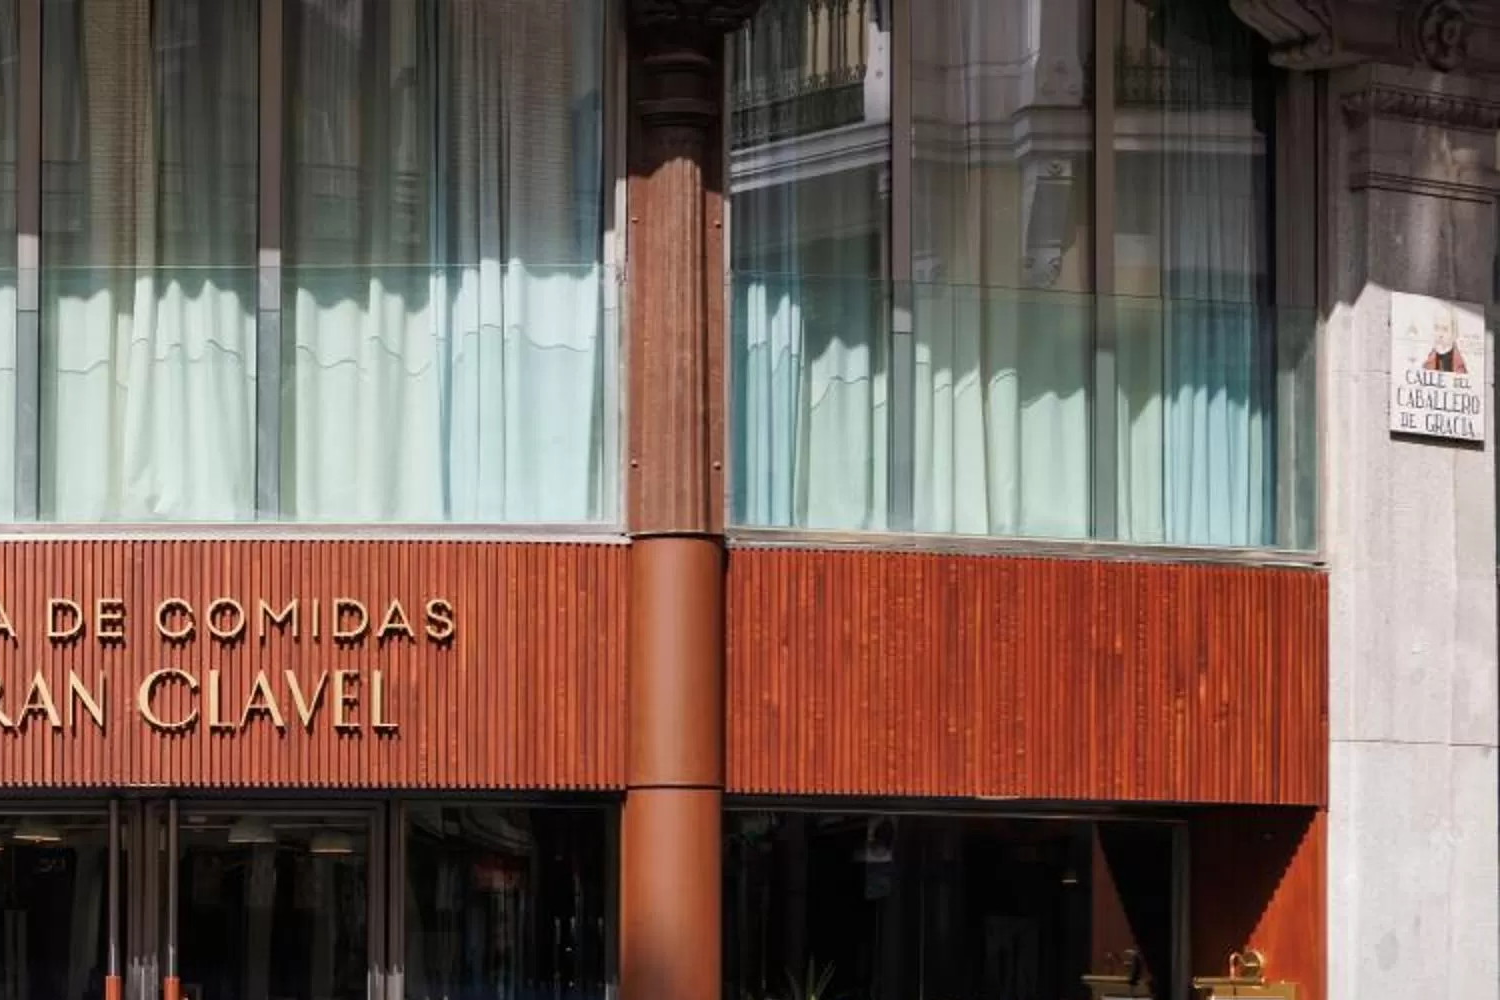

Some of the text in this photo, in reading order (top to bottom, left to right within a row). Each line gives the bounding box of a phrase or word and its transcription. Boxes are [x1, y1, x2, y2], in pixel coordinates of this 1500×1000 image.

[1405, 370, 1473, 389] CALLE DEL
[1397, 387, 1481, 415] CABALLERO
[1400, 412, 1477, 438] DE GRACIA
[46, 597, 126, 641] DE
[154, 597, 456, 641] COMIDAS
[137, 668, 400, 732] CLAVEL
